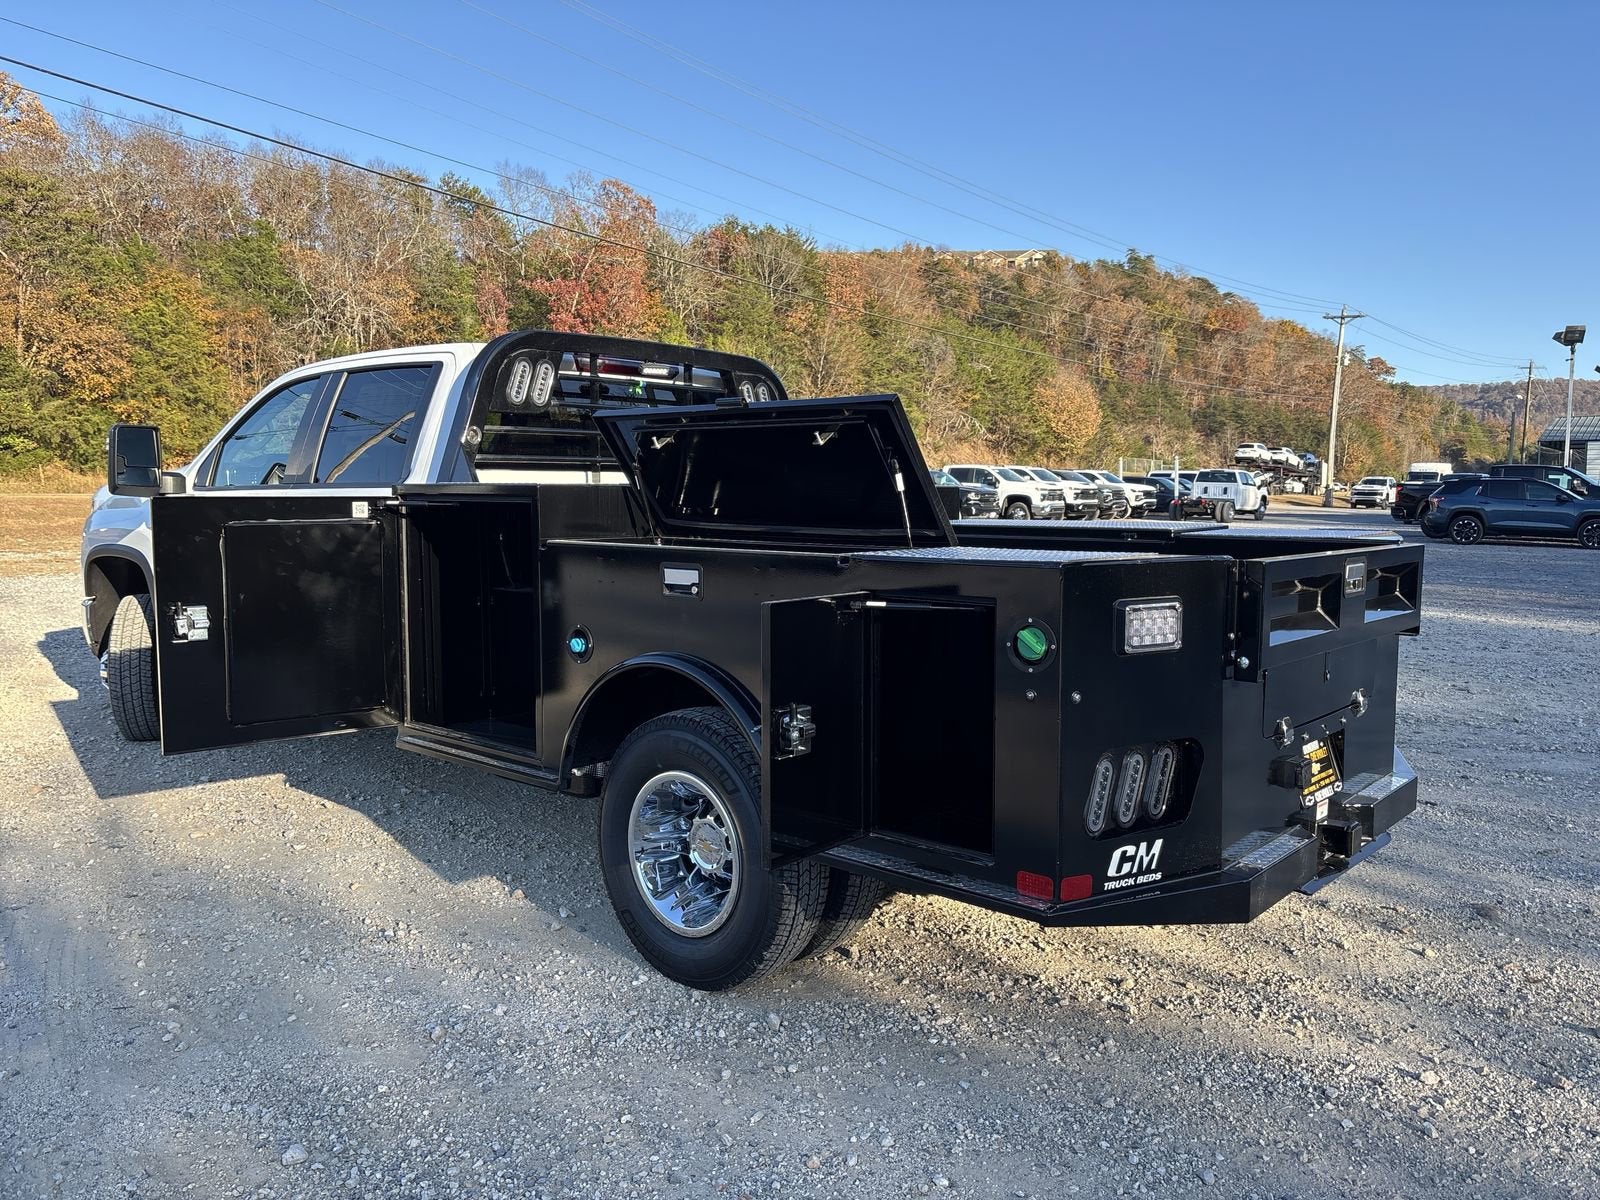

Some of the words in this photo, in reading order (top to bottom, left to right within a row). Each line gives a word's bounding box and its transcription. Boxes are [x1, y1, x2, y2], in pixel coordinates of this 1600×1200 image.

[1107, 838, 1164, 877] CM
[1103, 876, 1136, 891] TRUCK
[1136, 872, 1163, 884] BEDS
